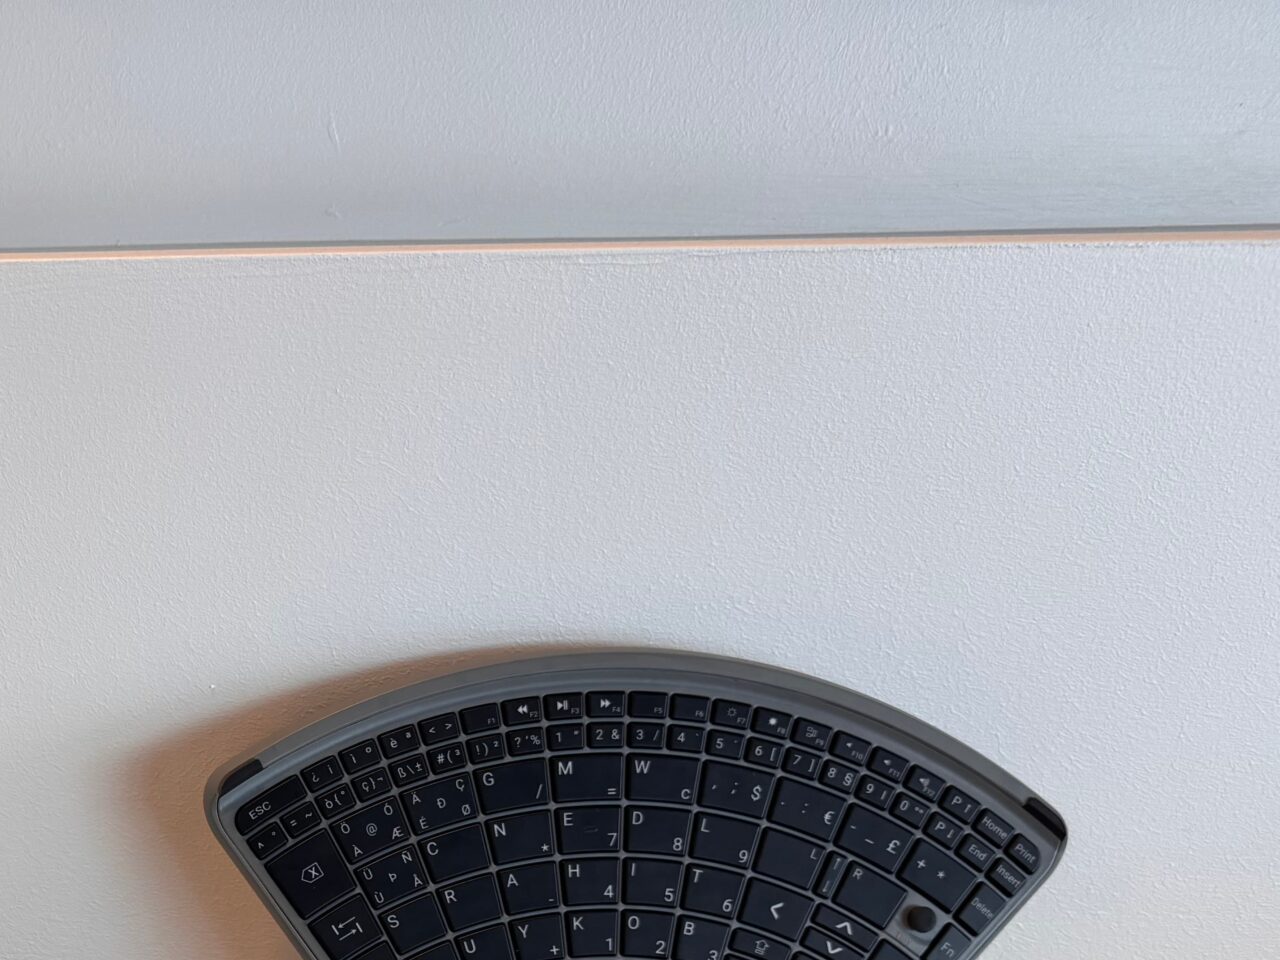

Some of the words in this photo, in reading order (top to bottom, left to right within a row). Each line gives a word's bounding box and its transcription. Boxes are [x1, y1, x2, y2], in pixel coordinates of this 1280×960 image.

[596, 729, 603, 740] 2
[636, 729, 643, 740] 3
[678, 733, 685, 742] 4
[716, 738, 723, 748] 5
[755, 746, 762, 755] 6
[793, 755, 801, 764] 7
[559, 761, 572, 774] M
[635, 760, 650, 773] W
[828, 768, 836, 777] 8
[483, 772, 494, 785] G
[751, 785, 761, 800] $
[866, 784, 874, 793] 9
[249, 802, 271, 819] ESC
[900, 800, 909, 810] 0
[564, 813, 573, 826] E
[632, 812, 643, 824] D
[824, 811, 834, 824] €
[366, 823, 377, 836] @
[494, 823, 506, 836] N
[701, 819, 709, 832] L
[983, 817, 1008, 841] Home
[608, 833, 619, 848] 7
[673, 838, 682, 851] 8
[887, 840, 900, 853] £
[427, 842, 438, 855] C
[969, 844, 987, 860] End
[1015, 844, 1035, 863] Print
[739, 850, 748, 862] 9
[569, 864, 579, 877] H
[693, 869, 703, 882] T
[997, 865, 1021, 888] Insert
[508, 874, 518, 887] A
[445, 890, 456, 903] R
[604, 885, 613, 897] 4
[665, 888, 673, 901] 5
[723, 899, 732, 912] 6
[972, 898, 994, 918] Delete
[388, 915, 399, 928] S
[573, 917, 583, 929] K
[628, 916, 639, 929] O
[518, 925, 528, 938] Y
[684, 922, 694, 935] B
[464, 940, 475, 953] U
[656, 941, 665, 954] 2
[941, 942, 954, 957] Fn
